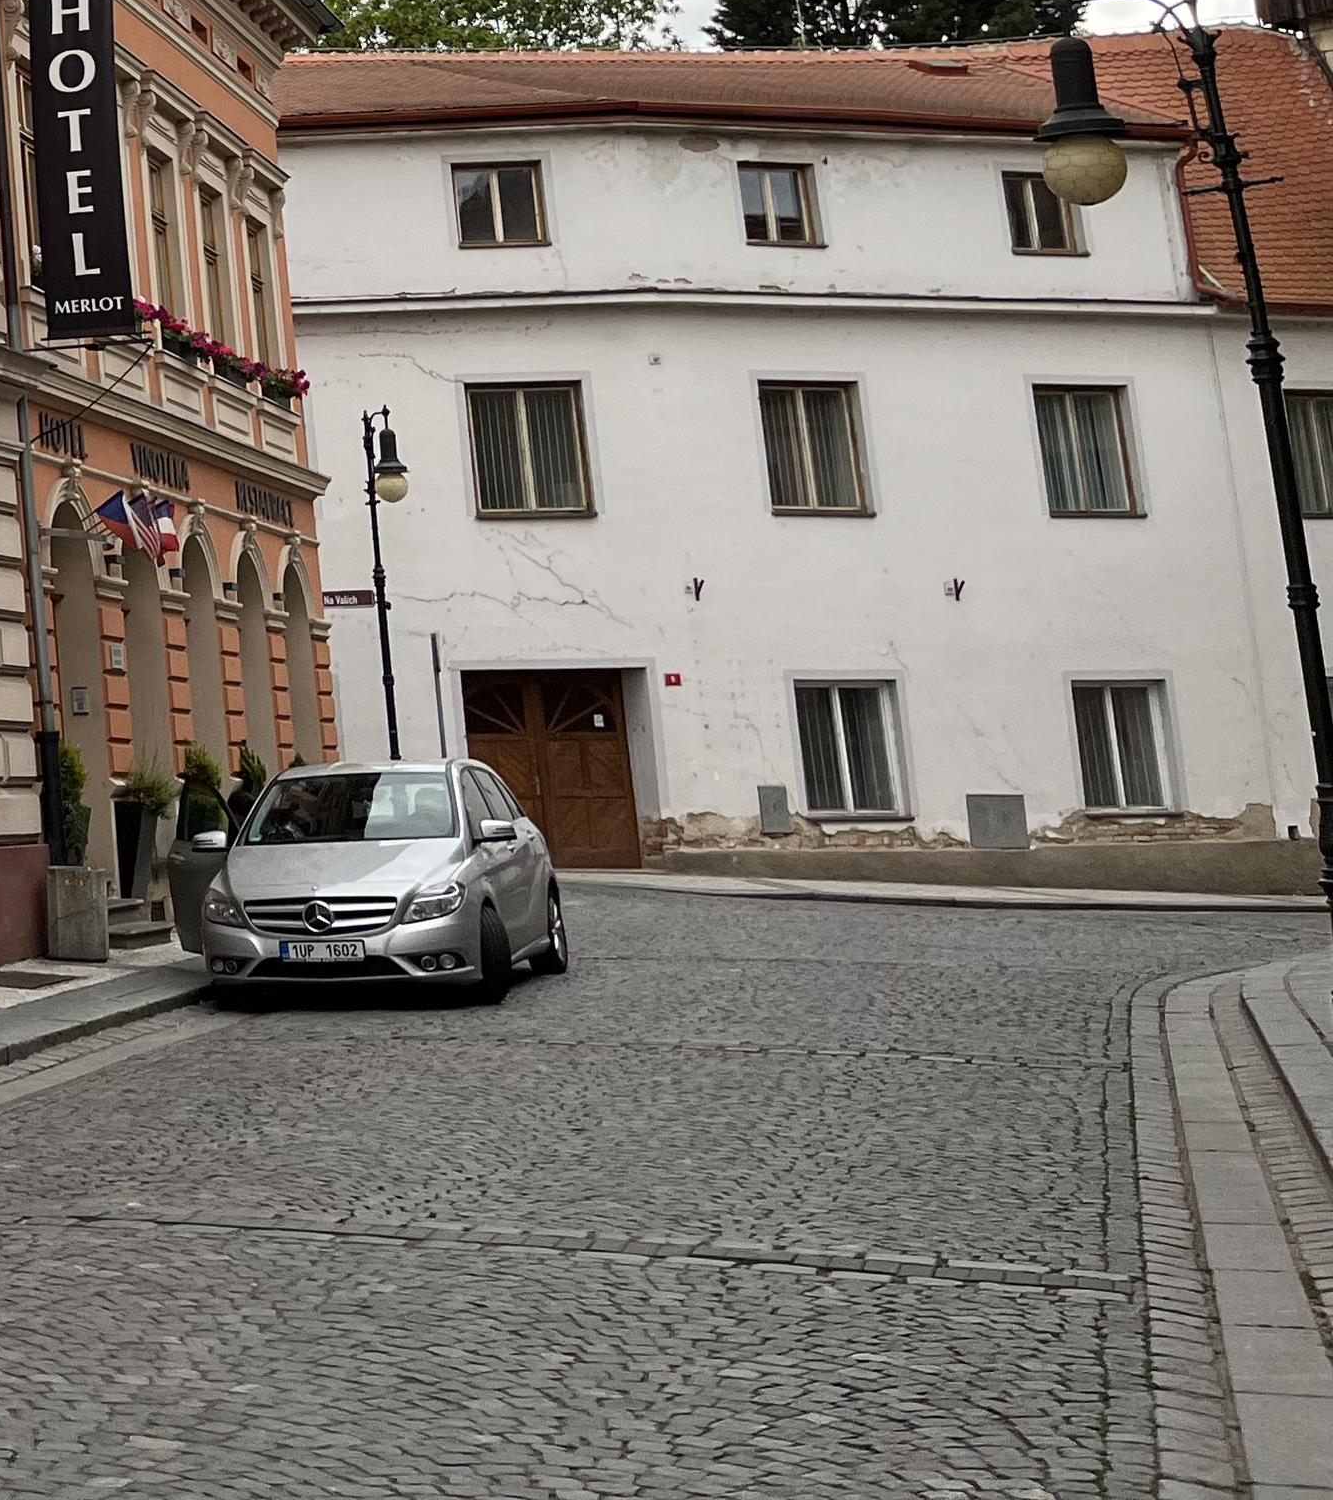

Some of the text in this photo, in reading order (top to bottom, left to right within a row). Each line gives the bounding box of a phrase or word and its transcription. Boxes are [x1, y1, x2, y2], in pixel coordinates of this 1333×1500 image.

[54, 296, 124, 315] MERLOT
[323, 595, 334, 605] Na
[292, 944, 315, 958] 1UP
[326, 943, 359, 957] 1602
